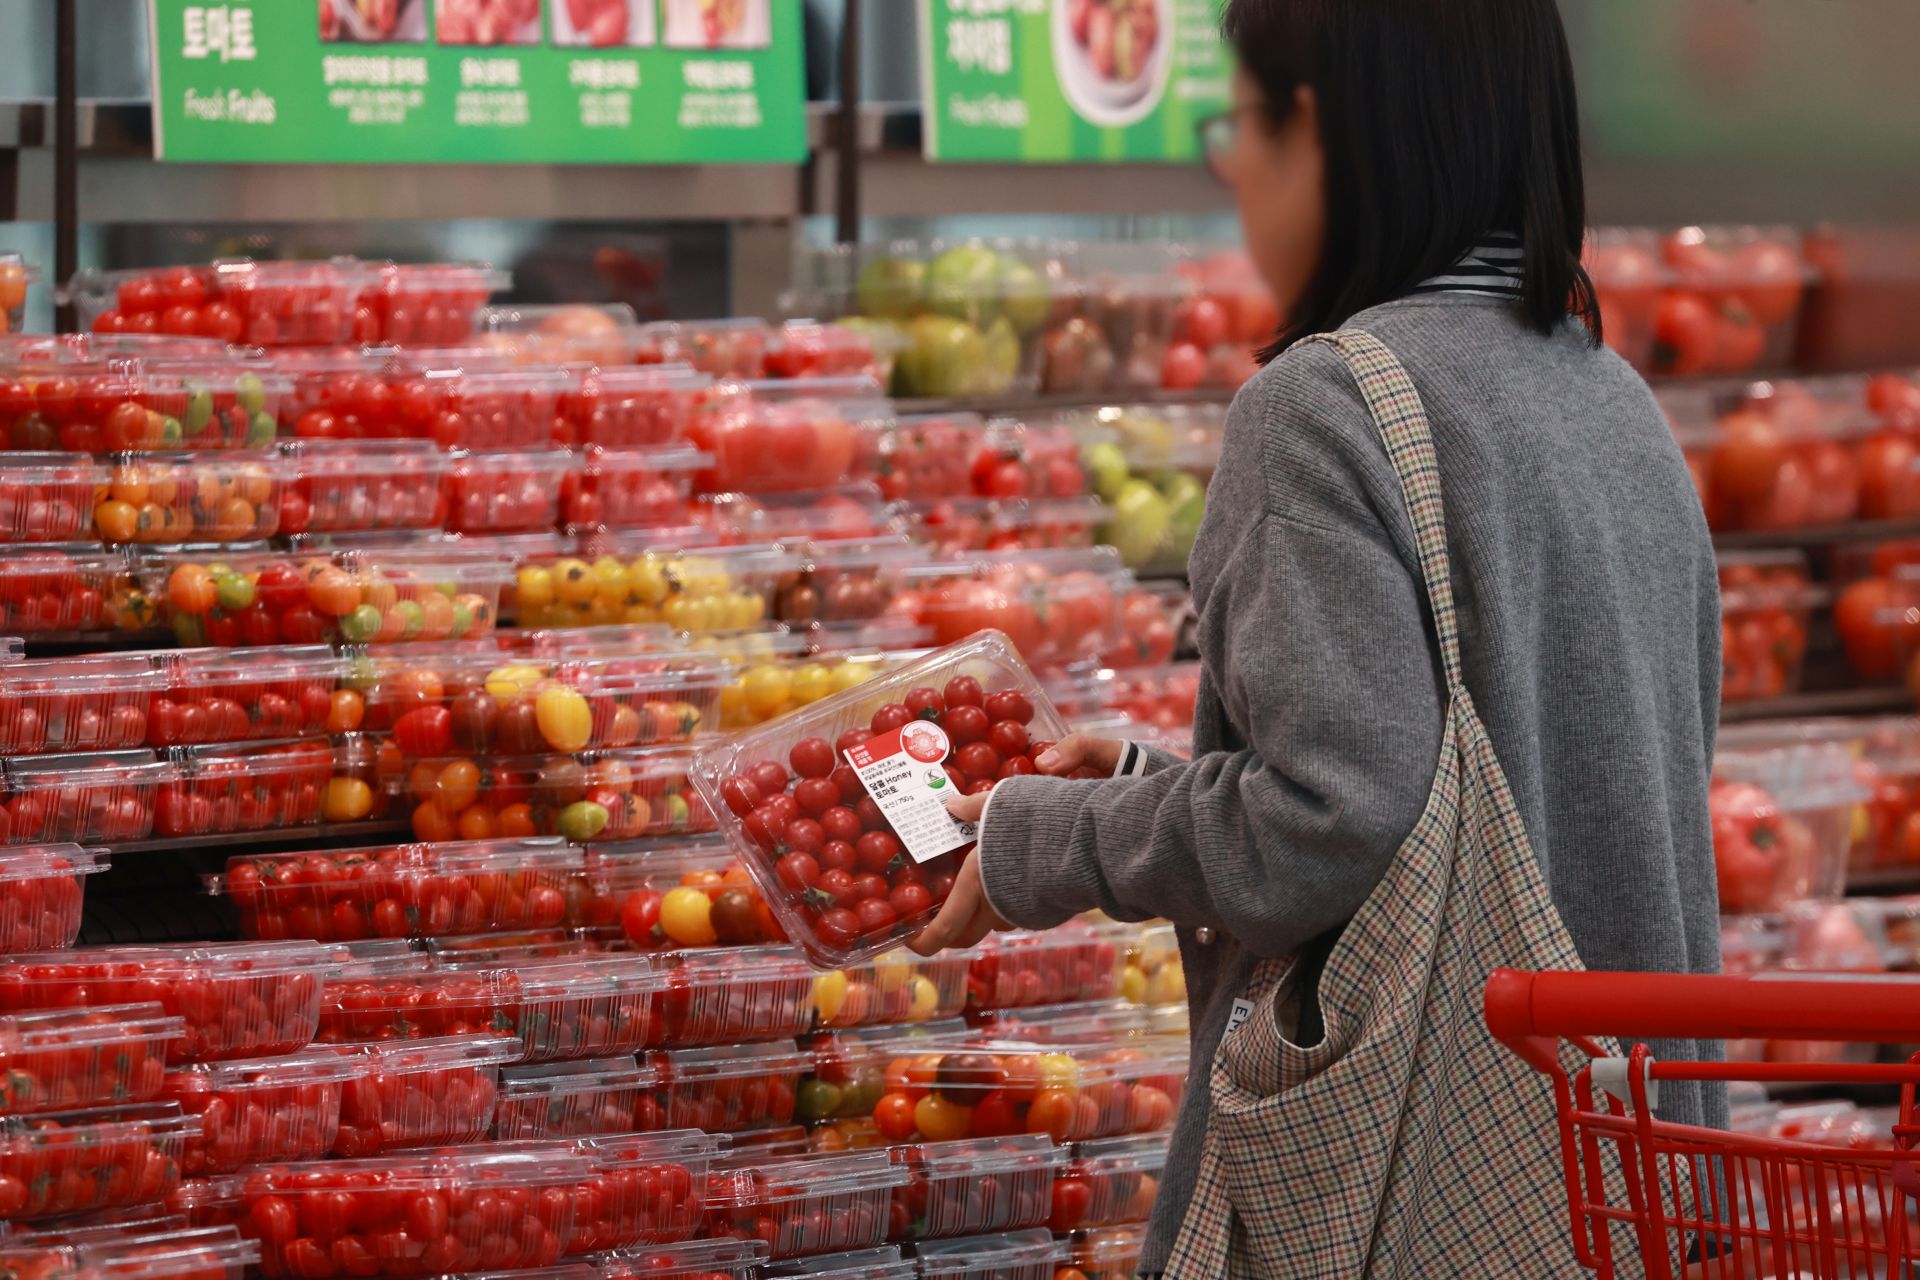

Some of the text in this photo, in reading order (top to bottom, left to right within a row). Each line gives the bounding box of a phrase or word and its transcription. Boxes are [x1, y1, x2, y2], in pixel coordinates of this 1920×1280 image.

[183, 6, 256, 62] 토마토
[885, 770, 912, 785] Honey
[875, 785, 898, 800] 토마토
